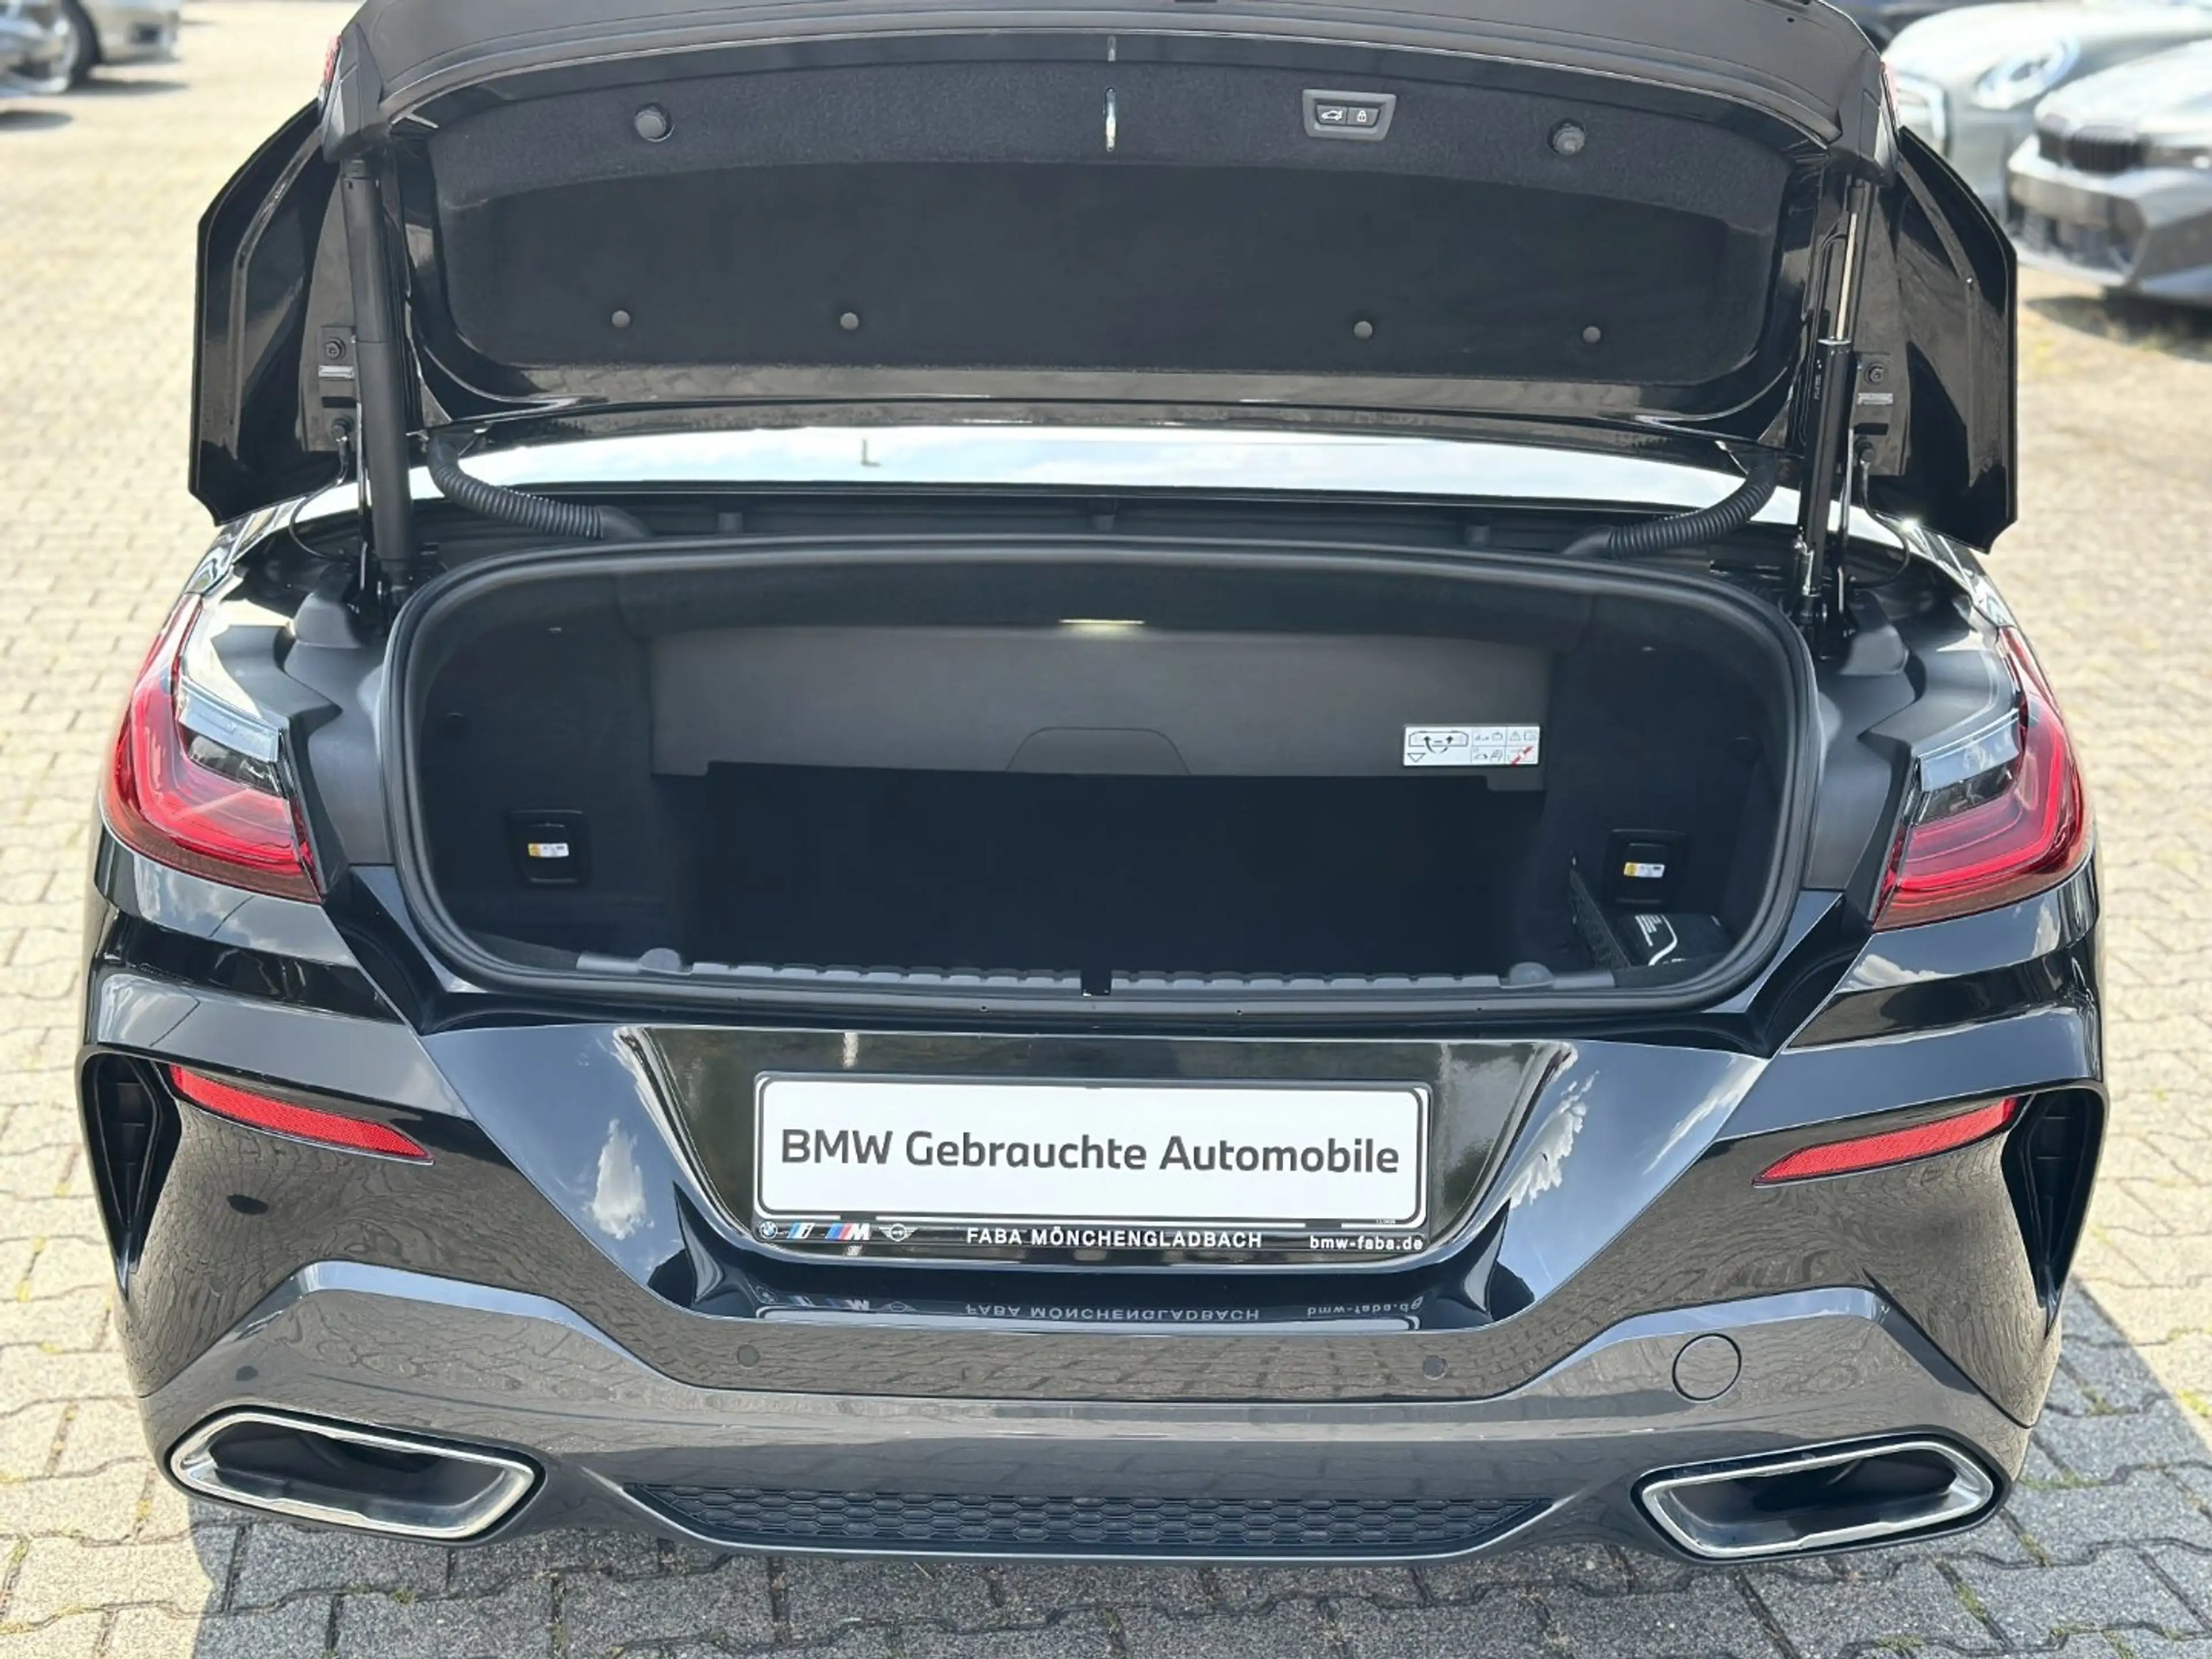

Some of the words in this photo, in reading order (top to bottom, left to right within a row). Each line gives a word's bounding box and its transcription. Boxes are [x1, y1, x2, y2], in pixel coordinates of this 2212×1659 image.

[782, 1128, 893, 1164] BMW
[906, 1130, 1147, 1169] Gebrauchte
[1159, 1135, 1399, 1173] Automobile
[966, 1227, 1023, 1244] FABA
[1031, 1226, 1263, 1248] MÖNCHENGLADBACH
[1309, 1235, 1423, 1250] bmw-faba.de
